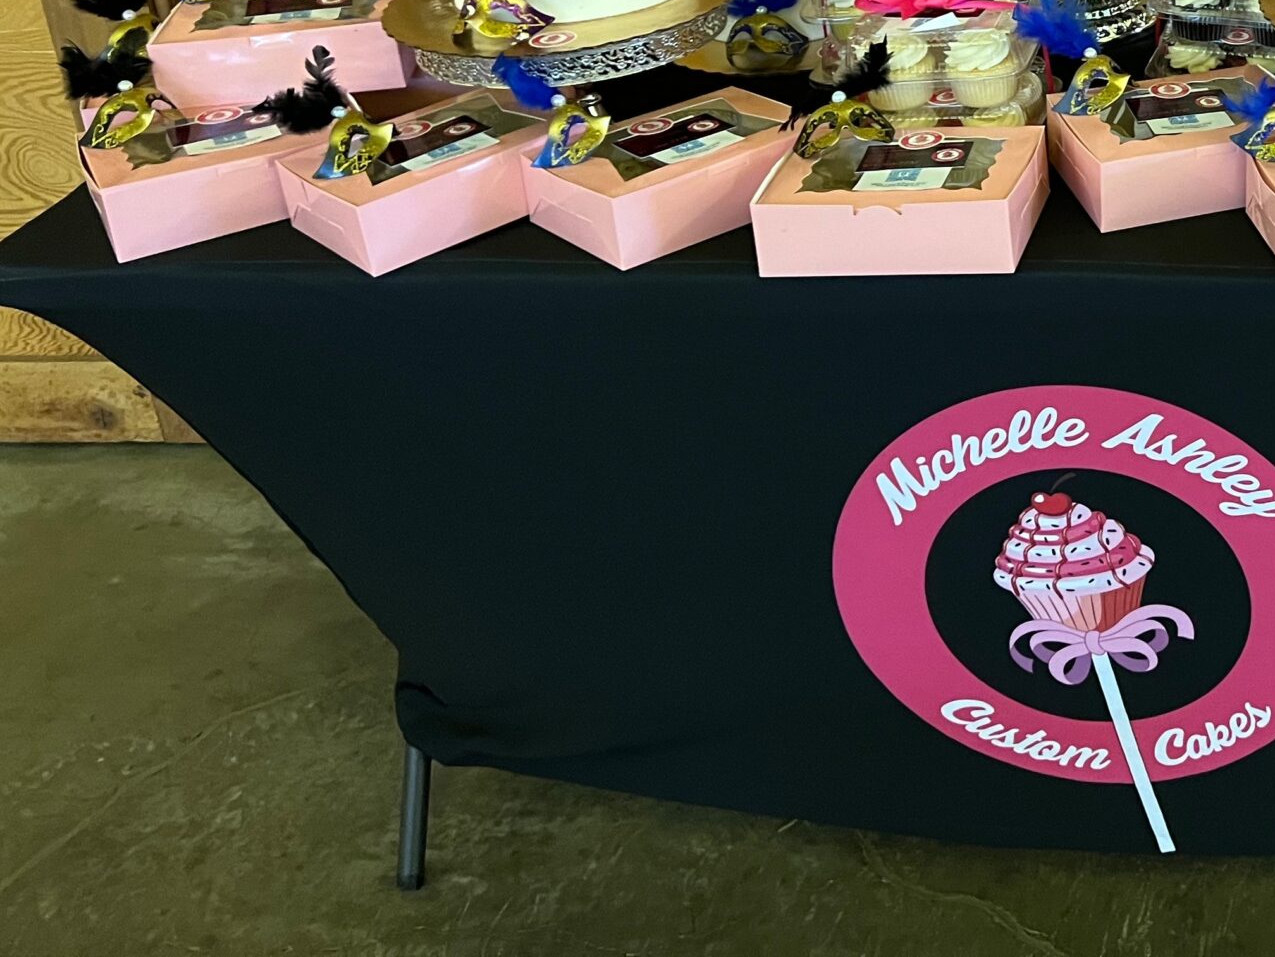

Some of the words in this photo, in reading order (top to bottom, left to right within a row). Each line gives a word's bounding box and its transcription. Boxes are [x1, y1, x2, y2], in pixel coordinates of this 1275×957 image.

[875, 406, 1090, 526] Michelle
[940, 699, 1112, 770] Custom
[1154, 702, 1272, 766] Cakes
